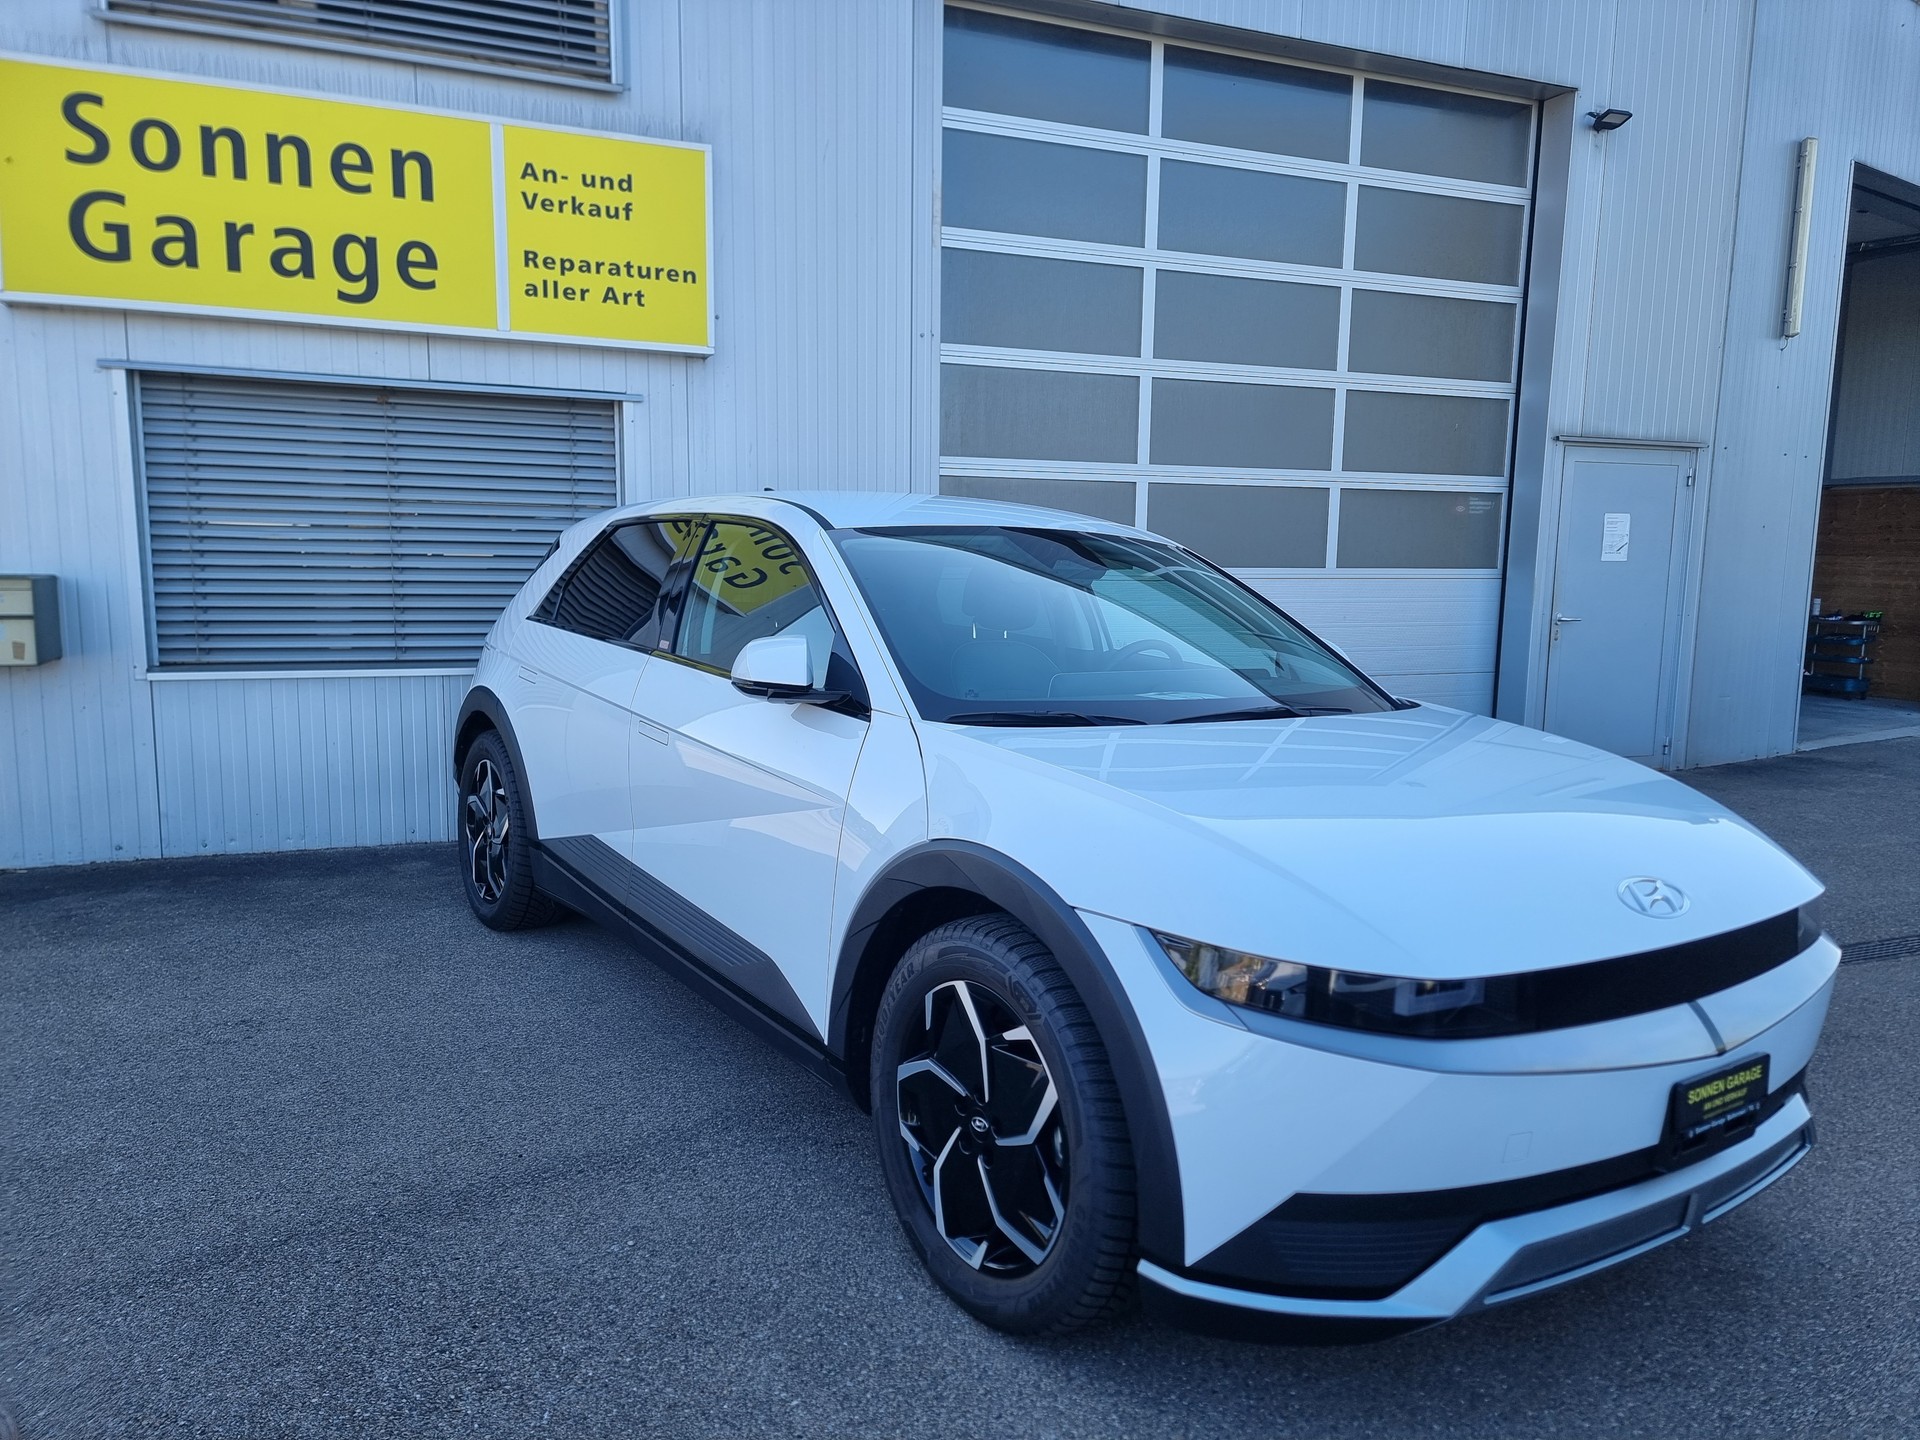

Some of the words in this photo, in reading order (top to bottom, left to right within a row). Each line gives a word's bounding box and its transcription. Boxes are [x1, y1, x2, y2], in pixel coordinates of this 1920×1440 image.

[60, 91, 436, 203] Sonnen
[520, 162, 570, 185] An-
[581, 174, 634, 193] und
[521, 191, 634, 221] Verkauf
[67, 189, 440, 305] Garage
[522, 250, 698, 285] Reparaturen
[524, 279, 591, 302] aller
[602, 286, 646, 307] Art
[1687, 1079, 1725, 1105] SONNEN
[1726, 1065, 1763, 1089] GARAGE
